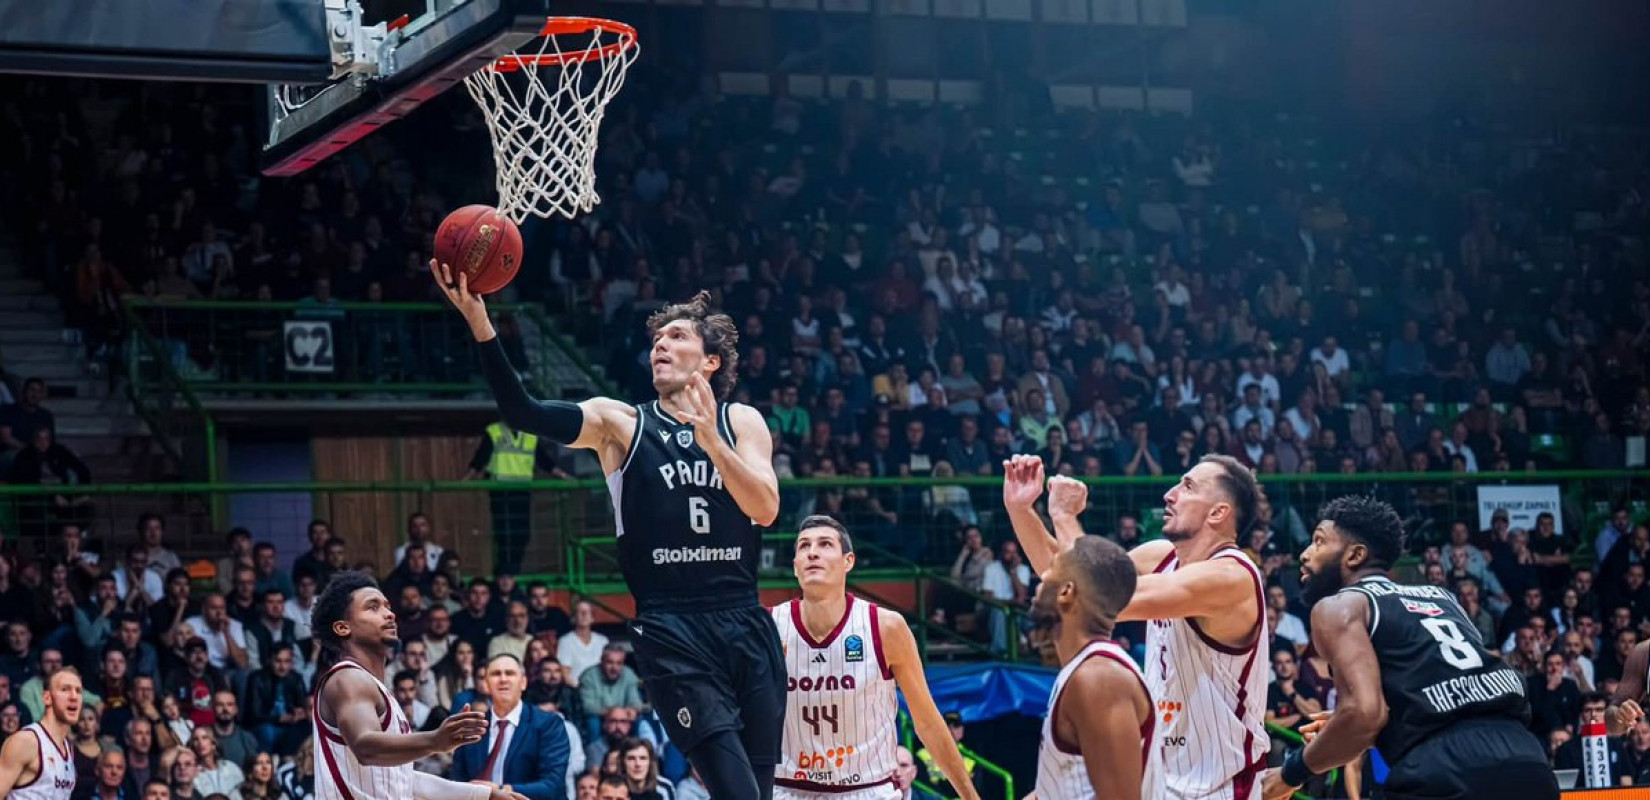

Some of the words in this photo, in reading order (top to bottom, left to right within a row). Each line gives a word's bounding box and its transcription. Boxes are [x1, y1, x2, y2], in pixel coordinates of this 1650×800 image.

[286, 326, 333, 367] C2
[688, 496, 710, 534] 6
[1420, 617, 1484, 670] 8
[802, 704, 838, 736] 44
[1596, 737, 1604, 747] 4
[798, 751, 825, 769] bh
[1597, 750, 1604, 761] 3
[807, 771, 833, 780] VISIT
[1599, 763, 1606, 775] 2
